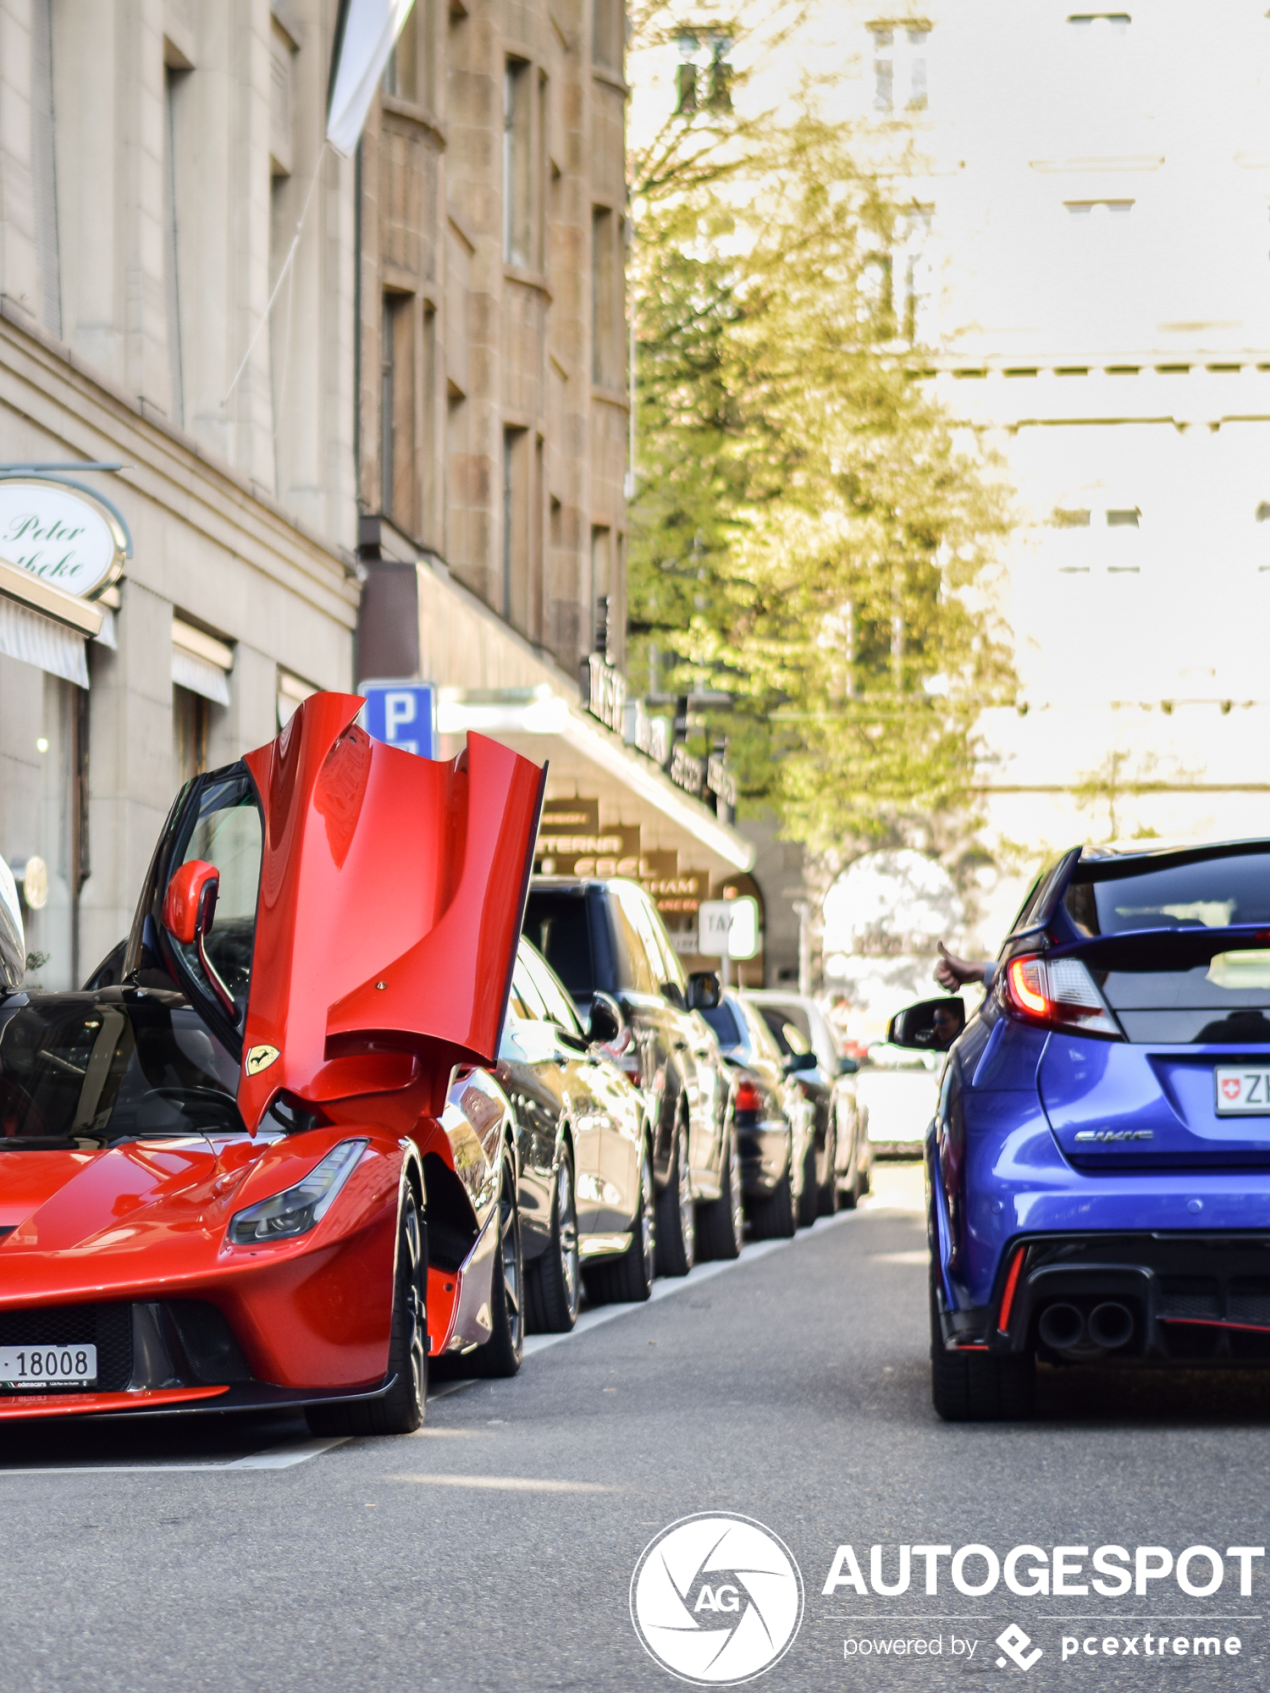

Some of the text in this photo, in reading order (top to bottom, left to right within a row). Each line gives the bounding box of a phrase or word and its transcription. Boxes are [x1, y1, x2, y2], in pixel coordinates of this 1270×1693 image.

[3, 513, 86, 542] Peter
[385, 693, 415, 740] P
[574, 857, 657, 877] EBEL
[16, 1351, 88, 1376] 18008
